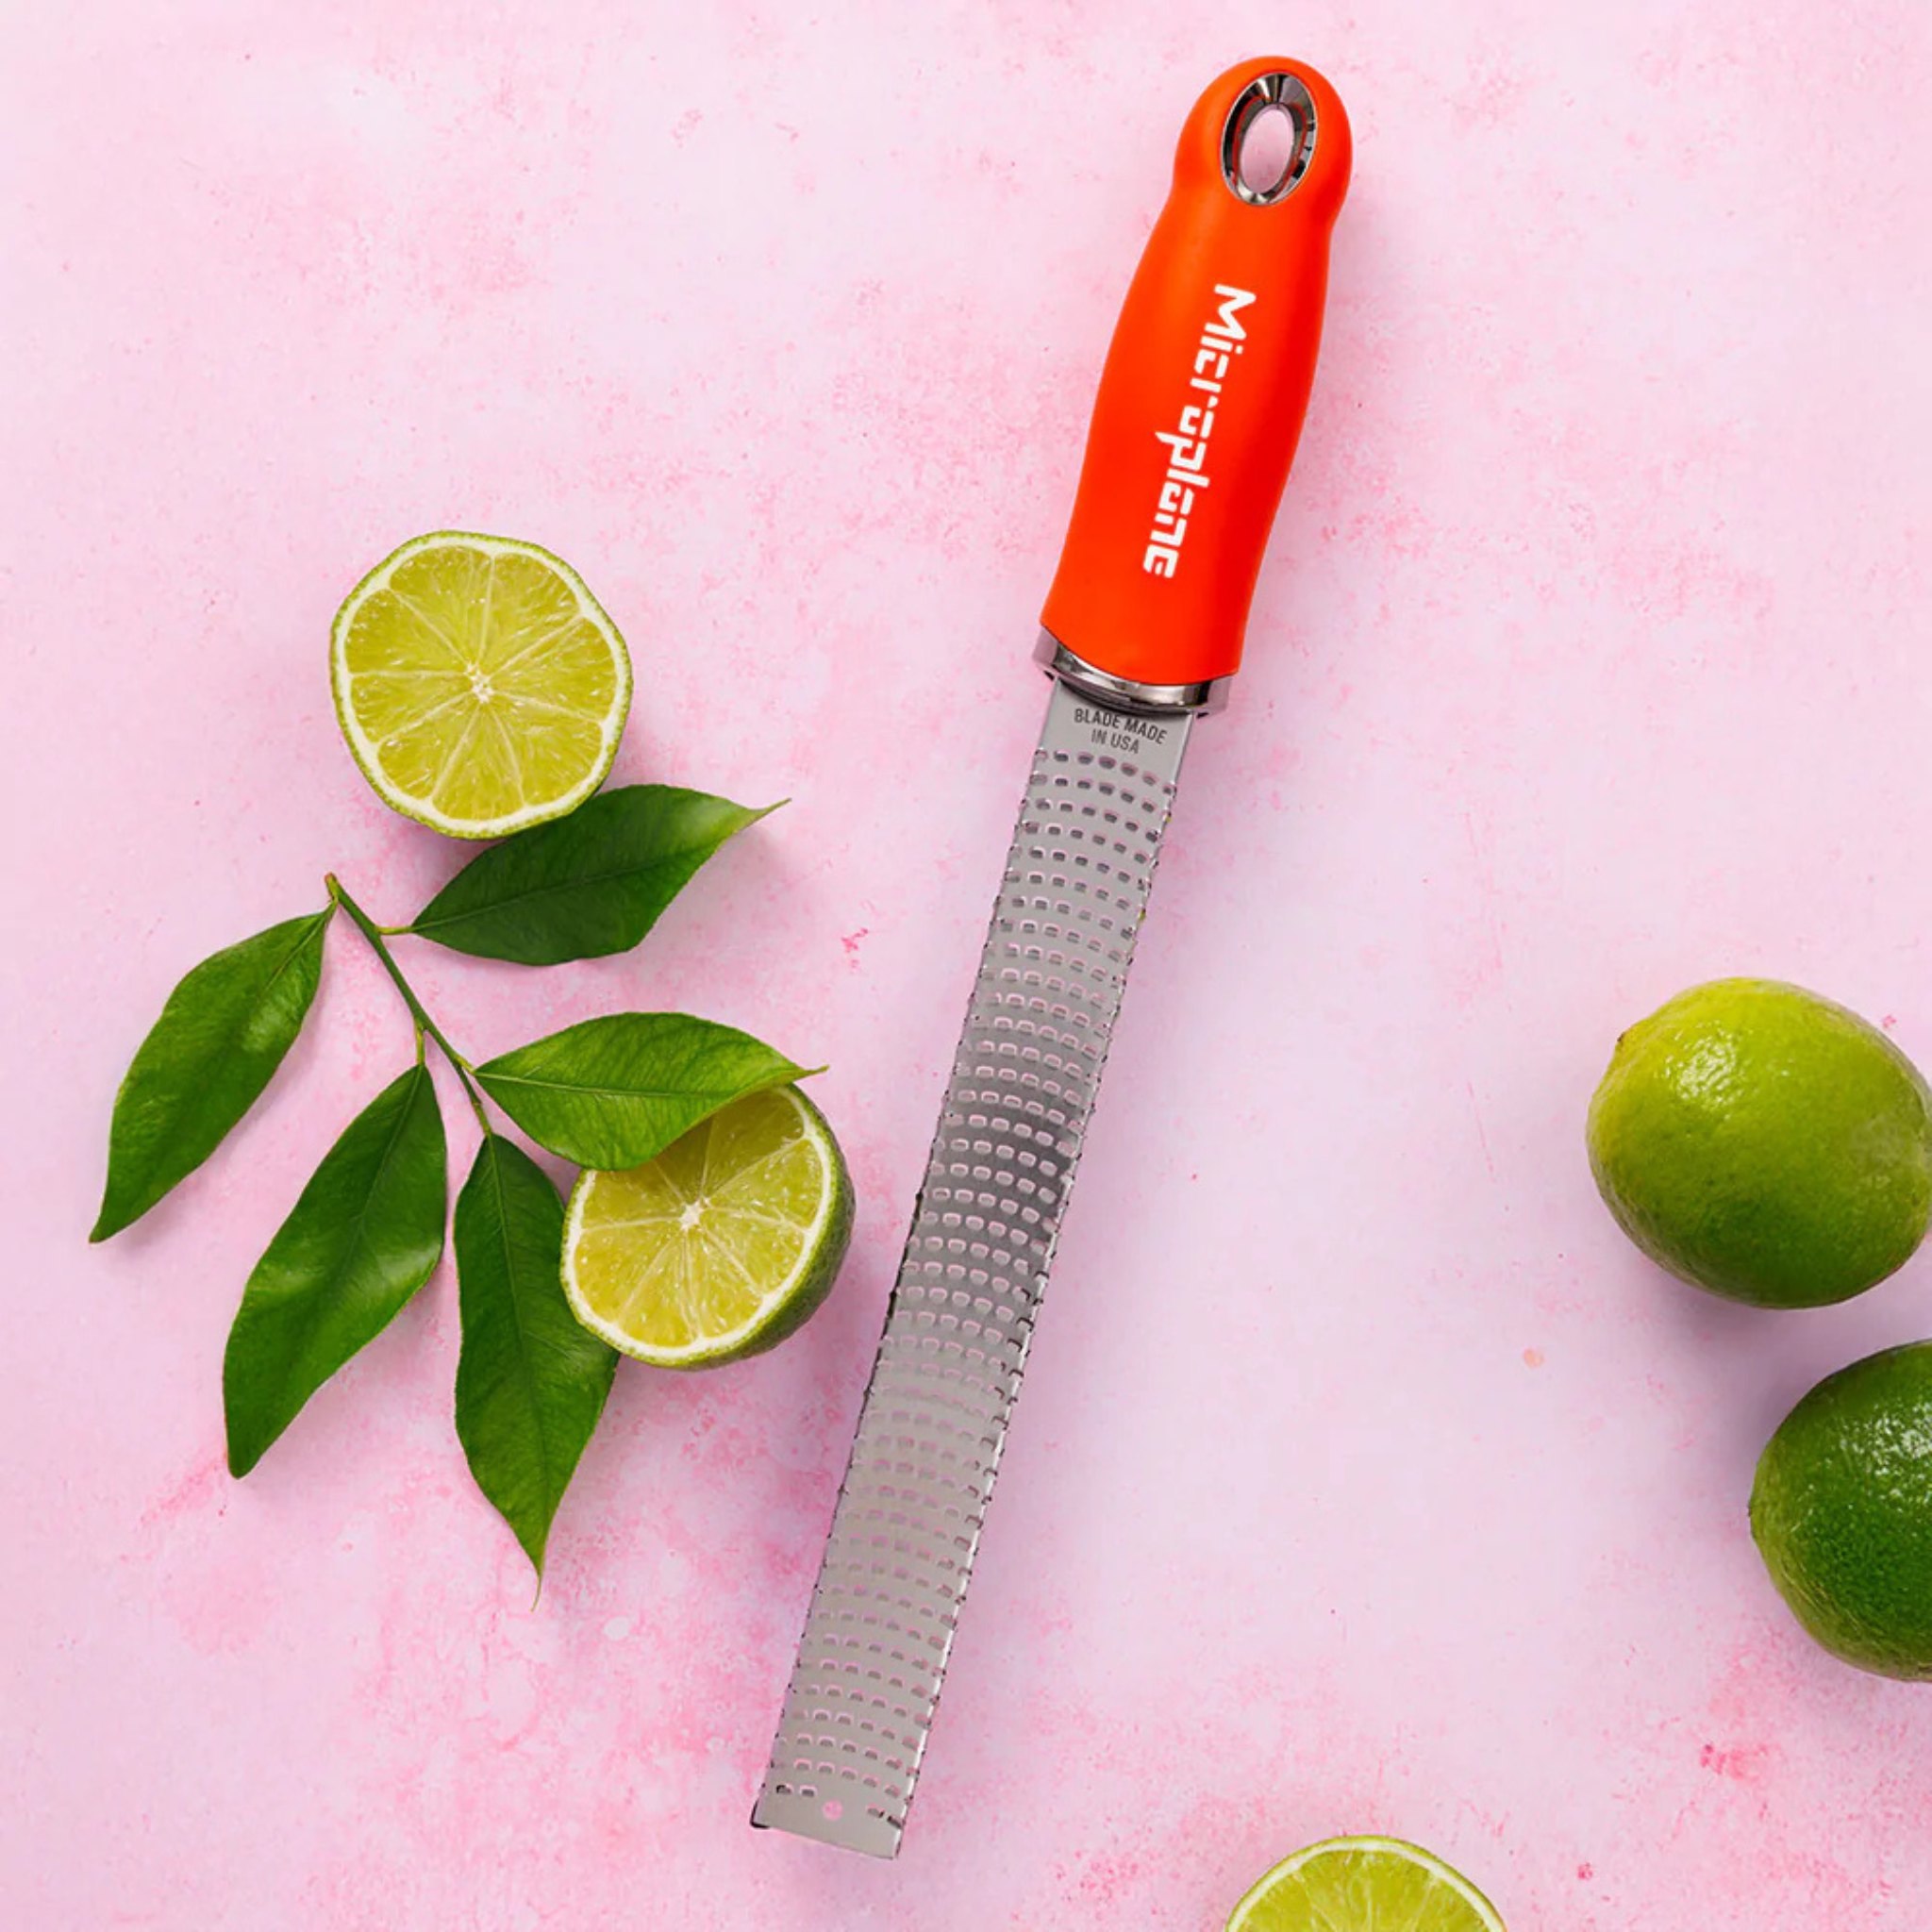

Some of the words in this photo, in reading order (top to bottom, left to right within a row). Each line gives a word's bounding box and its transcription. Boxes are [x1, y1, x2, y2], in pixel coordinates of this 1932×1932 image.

[1142, 283, 1257, 578] Microplane
[1074, 708, 1122, 729] BLADE
[1124, 719, 1168, 744] MADE
[1091, 728, 1108, 744] IN
[1110, 734, 1140, 754] USA
